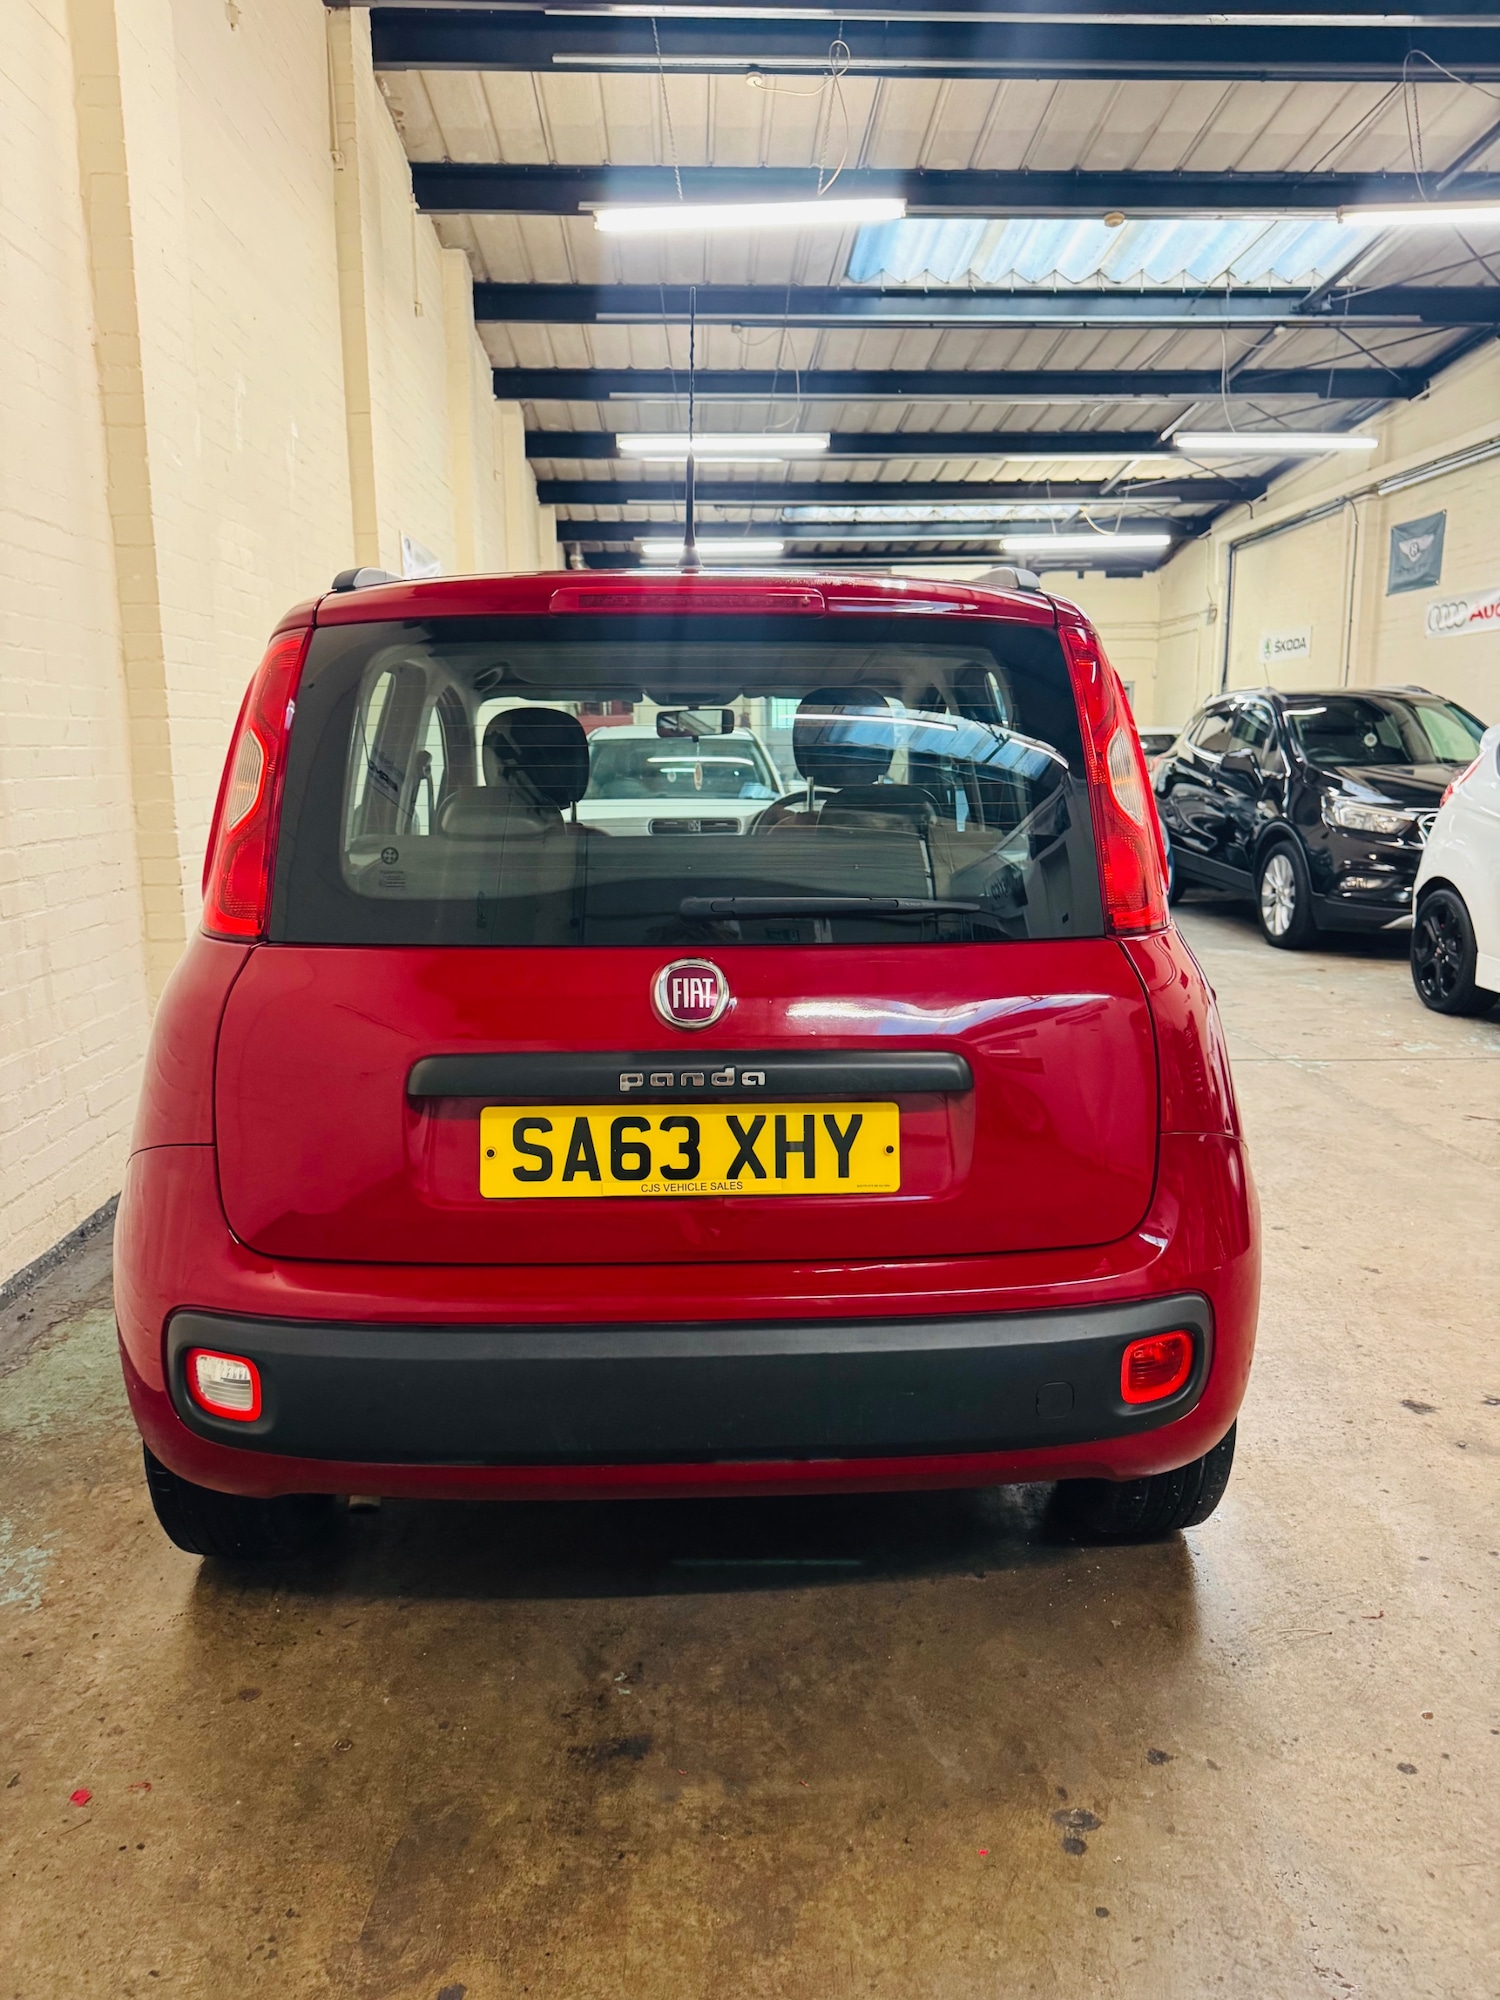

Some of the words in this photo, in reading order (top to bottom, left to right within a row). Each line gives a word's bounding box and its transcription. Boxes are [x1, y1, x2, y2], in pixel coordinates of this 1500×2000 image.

[672, 978, 714, 1008] FIAT
[619, 1067, 766, 1092] panda
[512, 1116, 701, 1182] SA63
[726, 1113, 863, 1180] XHY
[641, 1184, 661, 1193] CJS
[663, 1182, 707, 1192] VEHICLE
[710, 1181, 743, 1191] SALES
